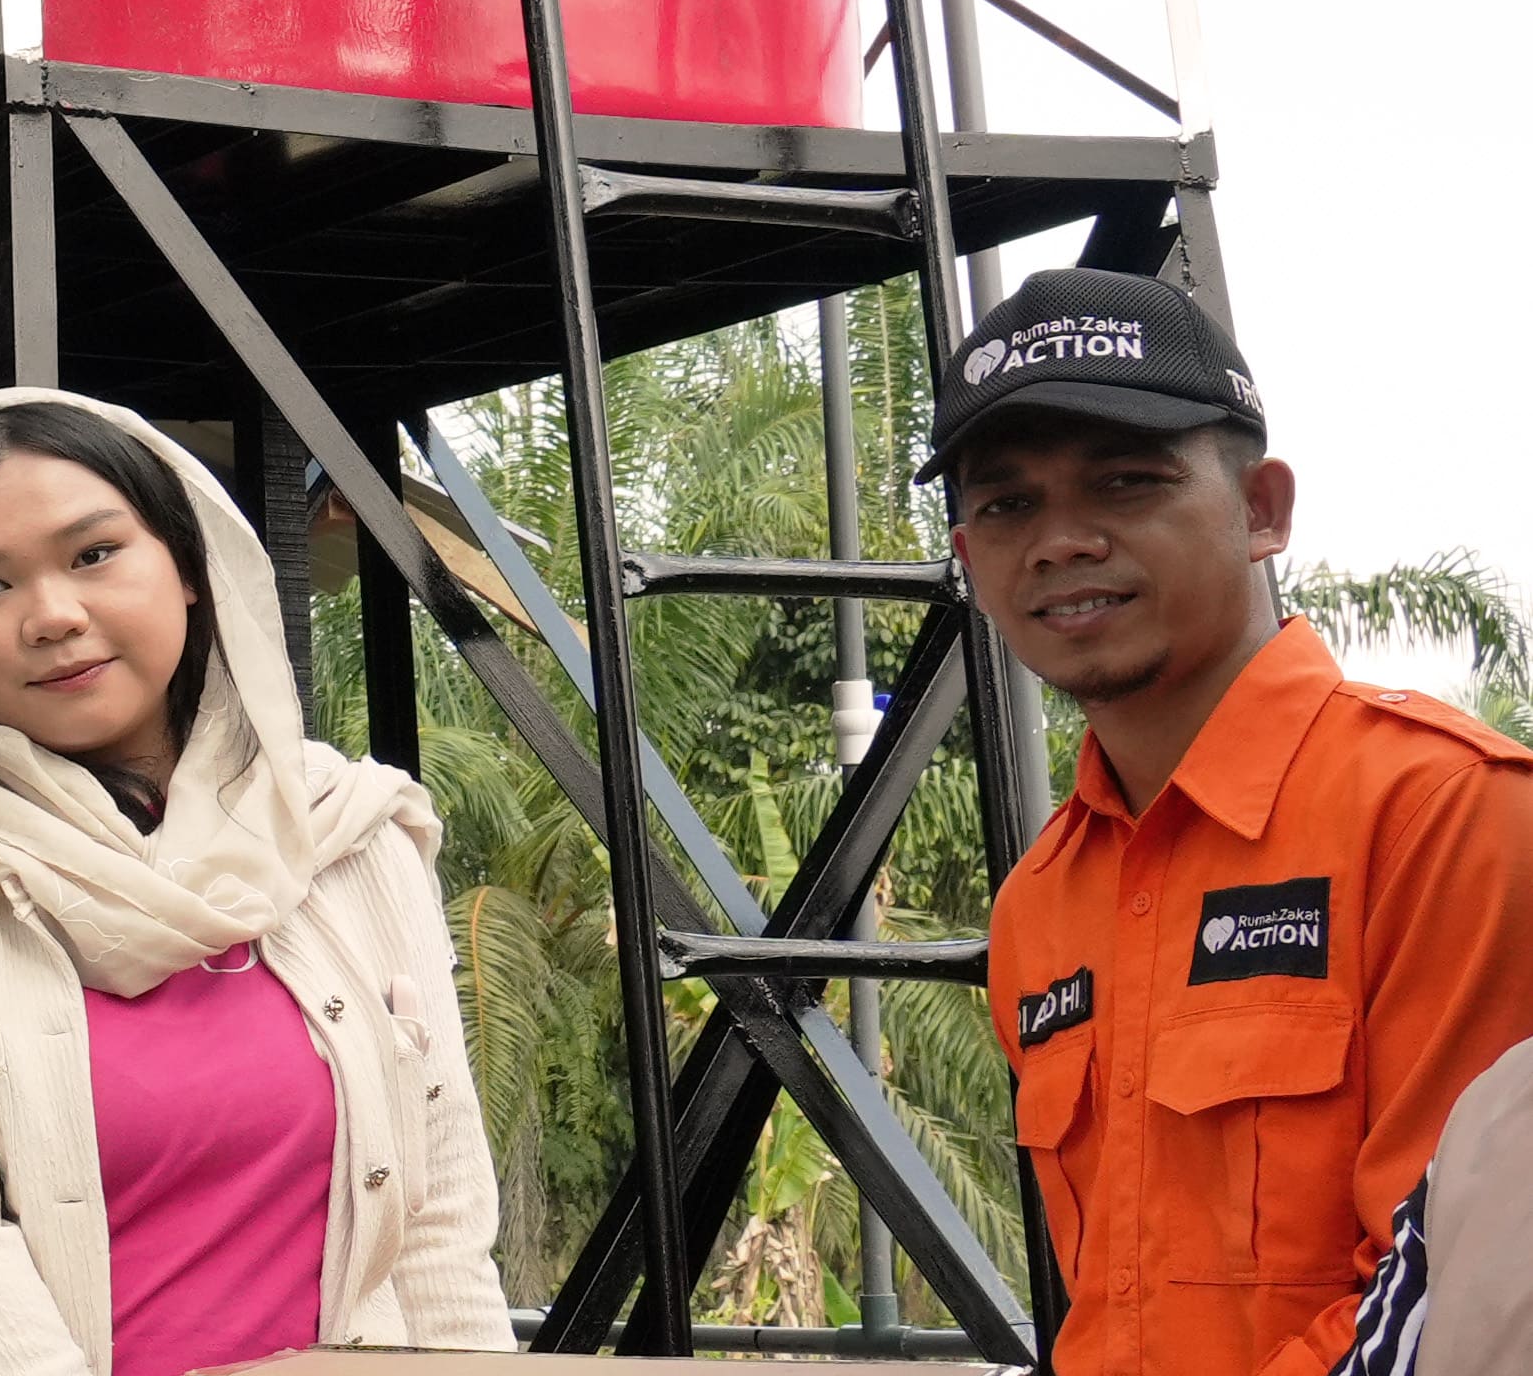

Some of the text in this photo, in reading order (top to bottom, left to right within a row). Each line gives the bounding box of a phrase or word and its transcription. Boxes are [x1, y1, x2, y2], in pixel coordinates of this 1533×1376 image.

[1010, 315, 1143, 347] Rumah Zakat
[1001, 333, 1144, 374] ACTION
[1279, 907, 1321, 923] Zakat
[1229, 924, 1320, 952] ACTION
